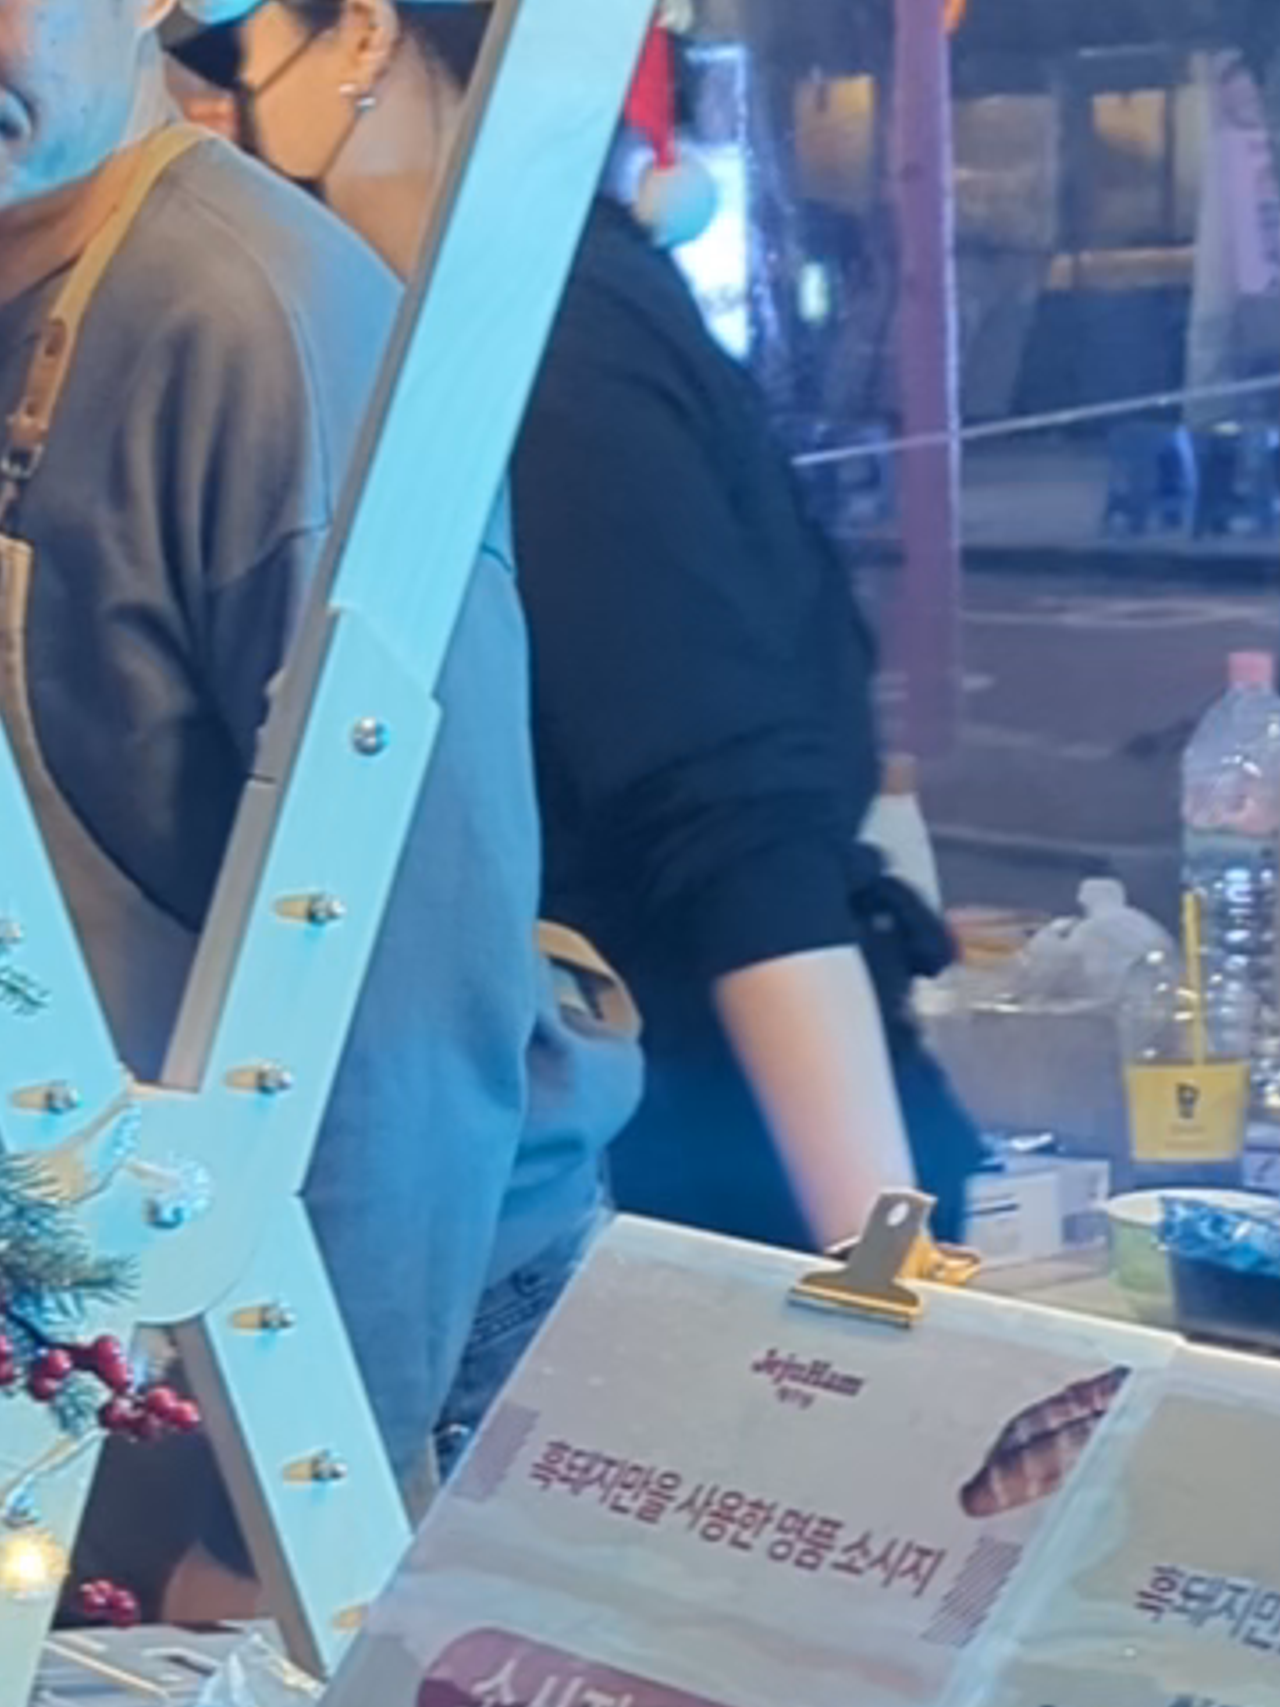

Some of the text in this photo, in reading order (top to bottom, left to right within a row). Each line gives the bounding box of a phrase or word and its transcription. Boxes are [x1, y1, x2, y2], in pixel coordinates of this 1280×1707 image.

[530, 1439, 947, 1597] 흑돼지만을 사용한 명품 소시지
